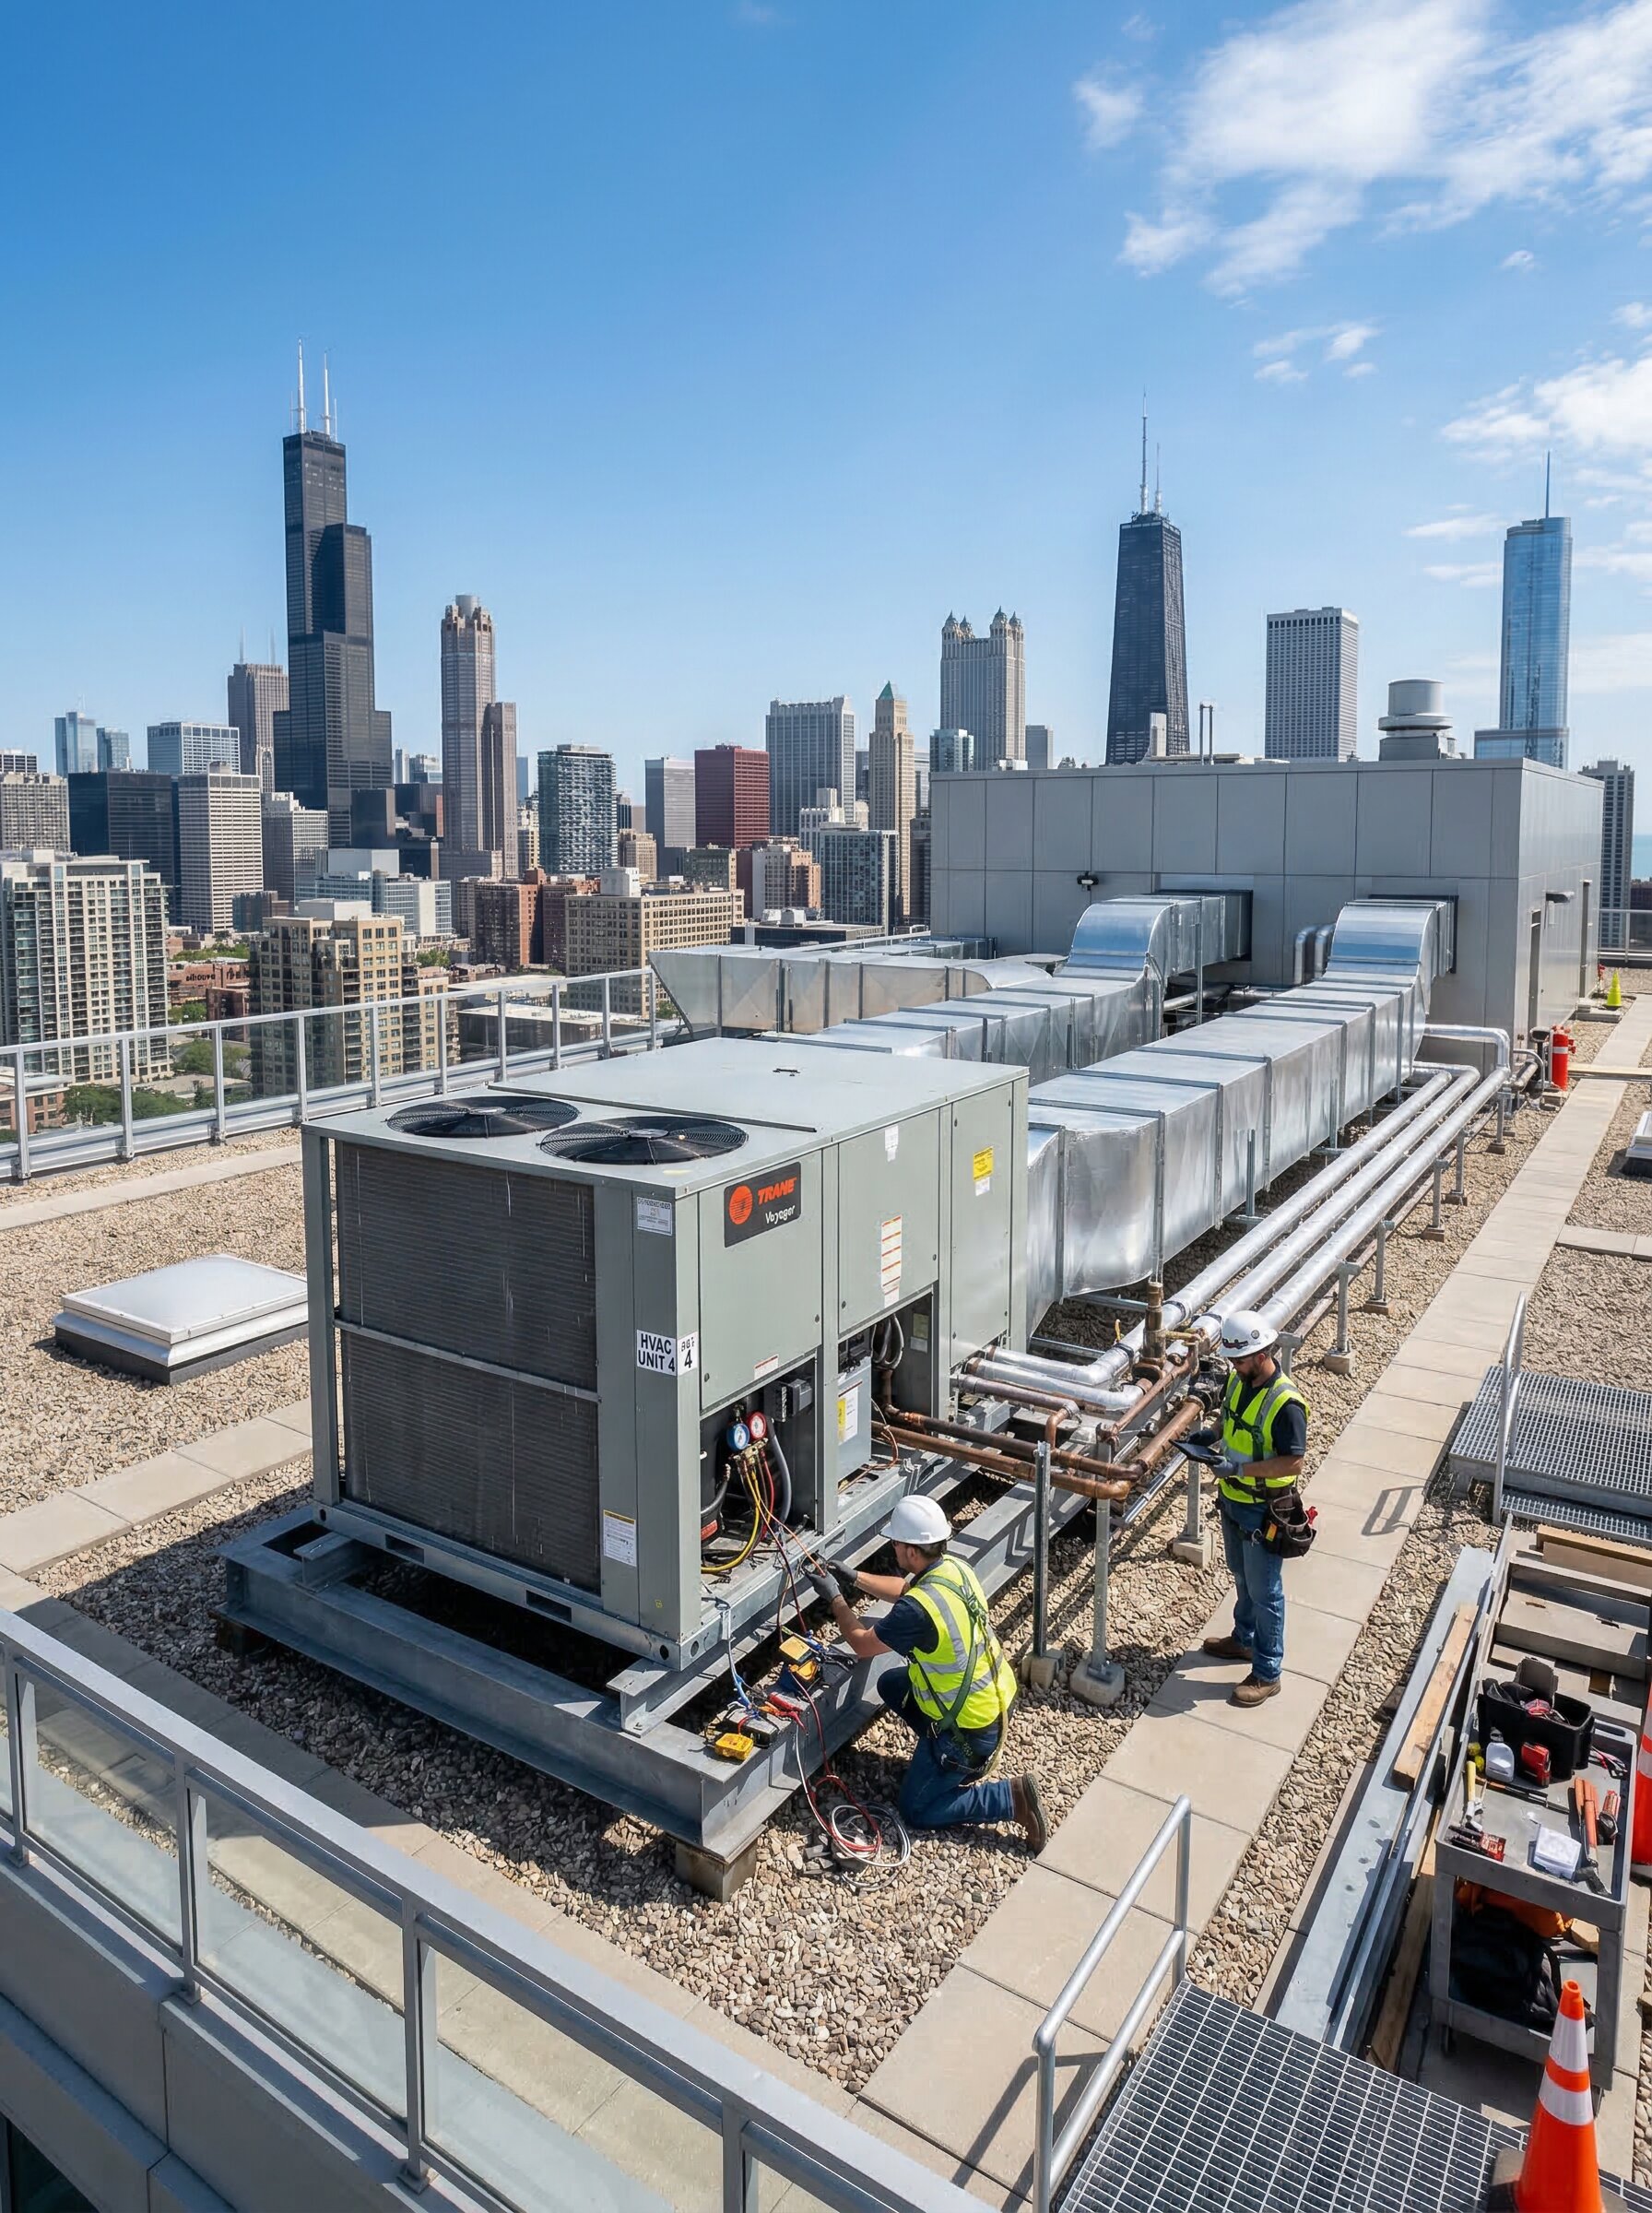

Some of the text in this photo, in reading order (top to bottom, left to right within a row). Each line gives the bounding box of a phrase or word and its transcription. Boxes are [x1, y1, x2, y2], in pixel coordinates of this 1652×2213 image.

[758, 1177, 796, 1204] TRANE
[641, 1333, 671, 1355] HVAC
[638, 1350, 675, 1372] UNIT 4
[684, 1349, 692, 1368] 4
